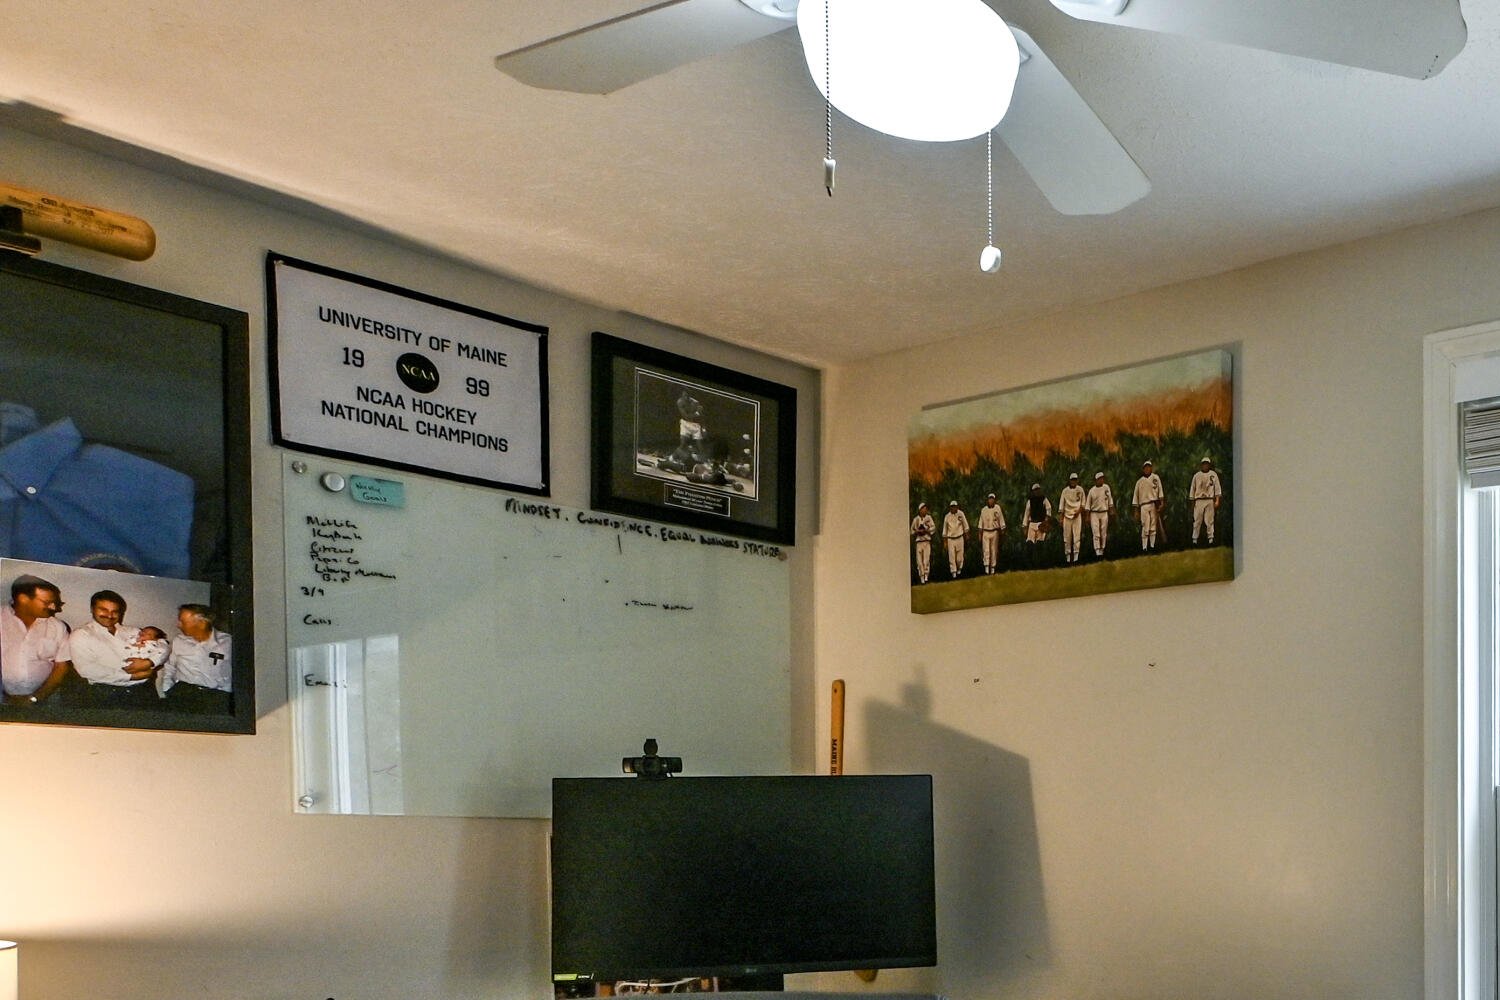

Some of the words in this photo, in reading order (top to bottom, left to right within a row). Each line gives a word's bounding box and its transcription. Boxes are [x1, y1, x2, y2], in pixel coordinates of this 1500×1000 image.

[318, 305, 422, 346] UNIVERSITY
[429, 336, 451, 353] OF
[457, 342, 508, 367] MAINE
[342, 346, 365, 368] 19
[401, 363, 436, 381] NCAA
[465, 377, 490, 397] 99
[357, 386, 406, 410] NCAA
[412, 398, 477, 425] HOCKEY
[321, 400, 409, 432] NATIONAL
[416, 420, 509, 453] CHAMPIONS
